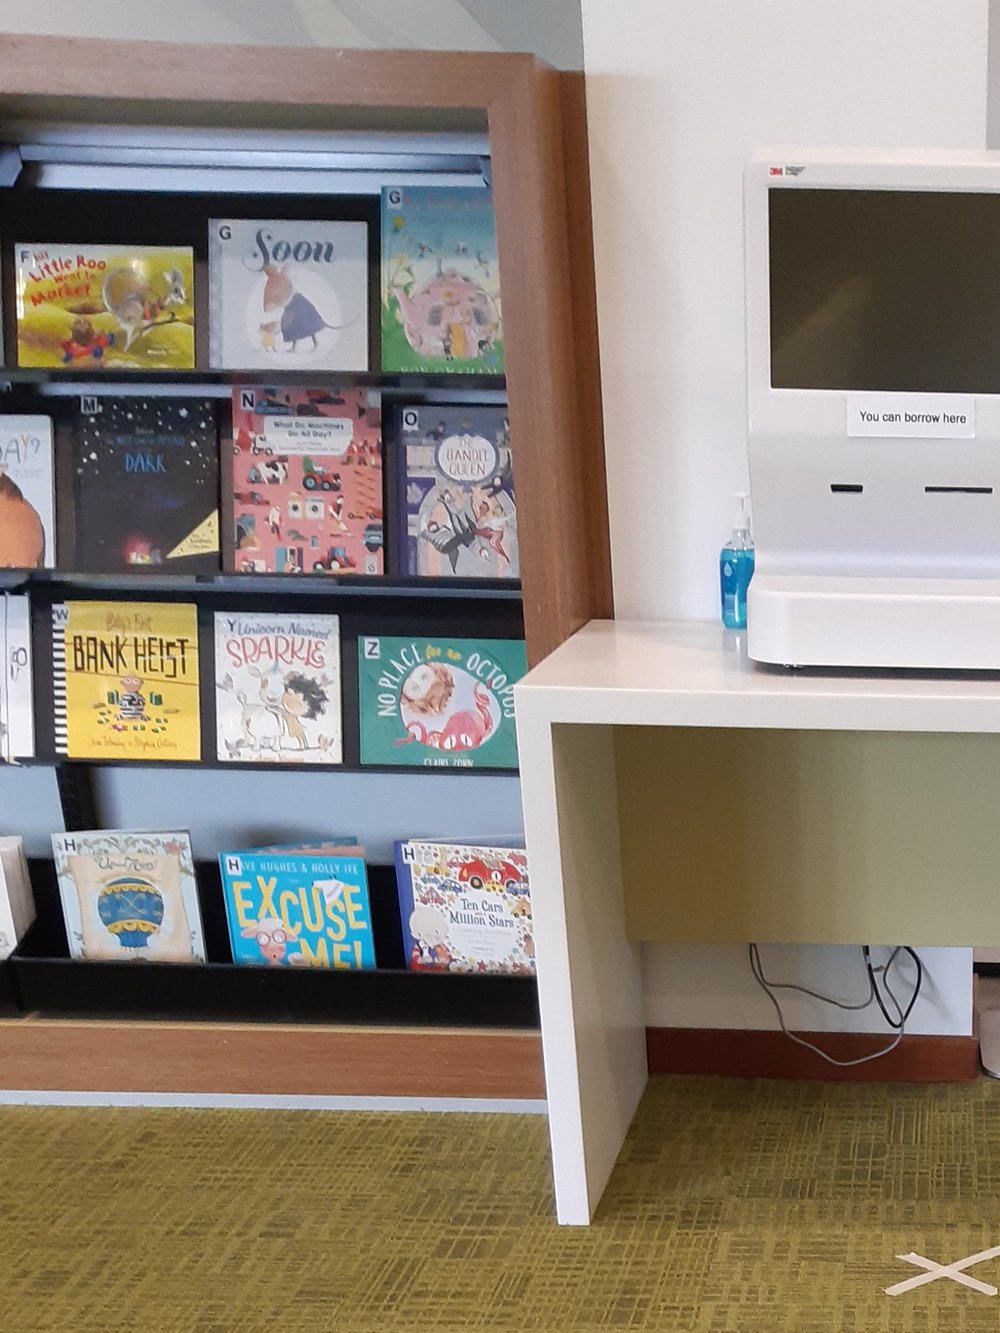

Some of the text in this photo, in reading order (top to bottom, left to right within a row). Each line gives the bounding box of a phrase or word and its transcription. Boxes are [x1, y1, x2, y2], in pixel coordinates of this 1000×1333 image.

[388, 191, 401, 204] G
[219, 226, 232, 240] G
[21, 250, 30, 263] F
[242, 227, 334, 272] Soon
[29, 255, 107, 283] Little Roo
[30, 284, 90, 307] Market
[242, 393, 254, 408] N
[404, 411, 418, 426] O
[859, 410, 967, 424] You can borrow here
[0, 433, 40, 464] AY?
[446, 447, 488, 462] BANDIT
[125, 452, 167, 474] DARK
[227, 618, 236, 632] Y
[240, 622, 332, 640] Unicorn Named
[226, 635, 326, 669] SPARKLE
[367, 641, 379, 656] Z
[73, 634, 128, 674] BANK
[133, 636, 189, 679] HEIST
[377, 692, 398, 717] NO
[64, 839, 76, 852] H
[404, 847, 415, 860] H
[228, 858, 240, 871] H
[260, 862, 298, 874] HUGHES
[301, 863, 308, 874] &
[311, 862, 341, 875] HOLLY
[232, 875, 368, 942] EXCUSE
[460, 898, 503, 913] Ten Cars
[449, 910, 514, 929] Million Stars
